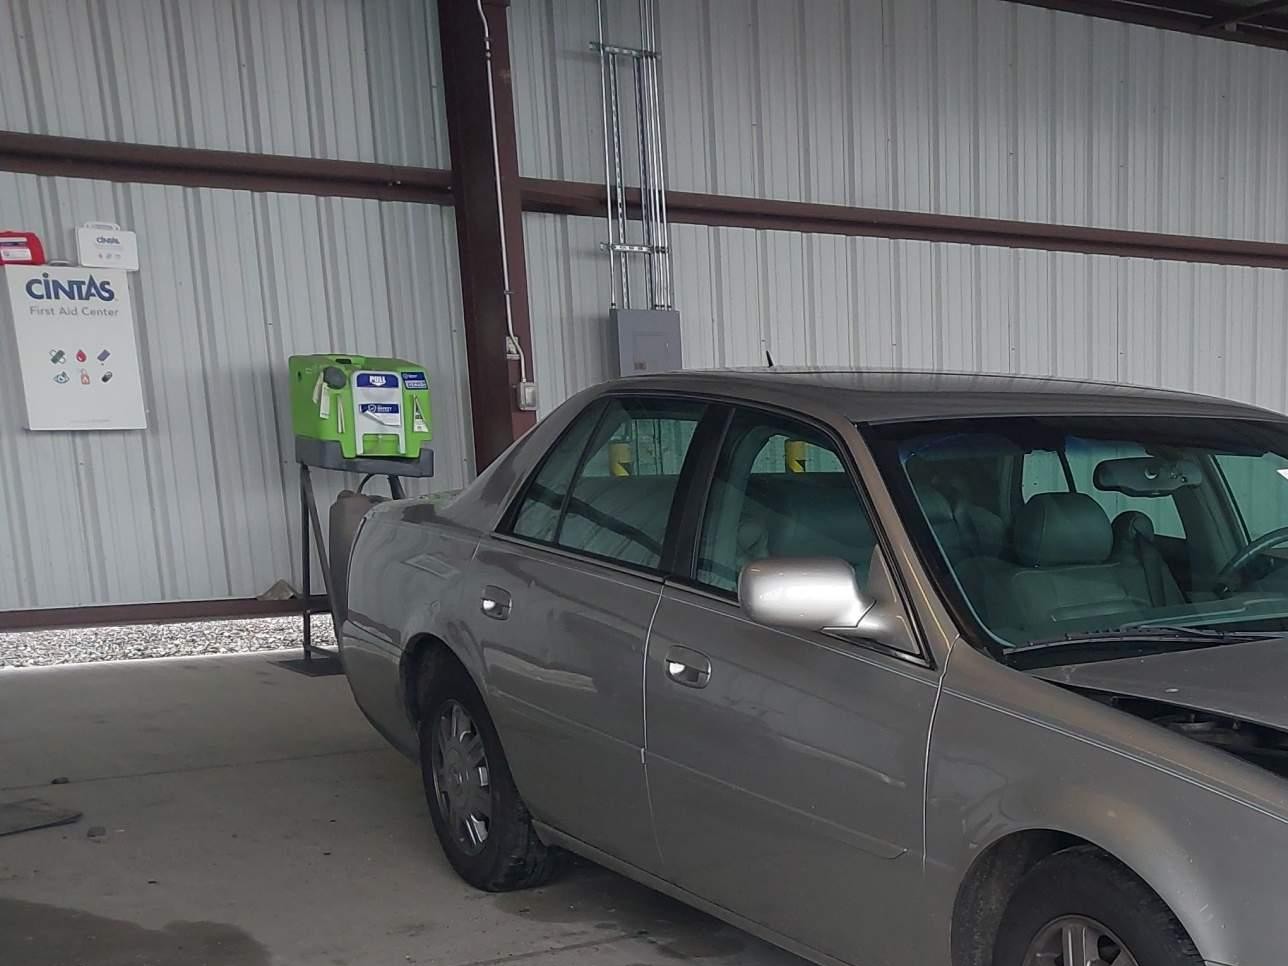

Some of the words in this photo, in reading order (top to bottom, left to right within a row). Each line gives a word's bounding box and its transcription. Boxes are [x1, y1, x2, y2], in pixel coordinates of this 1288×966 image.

[30, 306, 55, 316] First
[59, 306, 78, 316] Aid
[81, 306, 119, 317] Center
[369, 375, 387, 383] PULL
